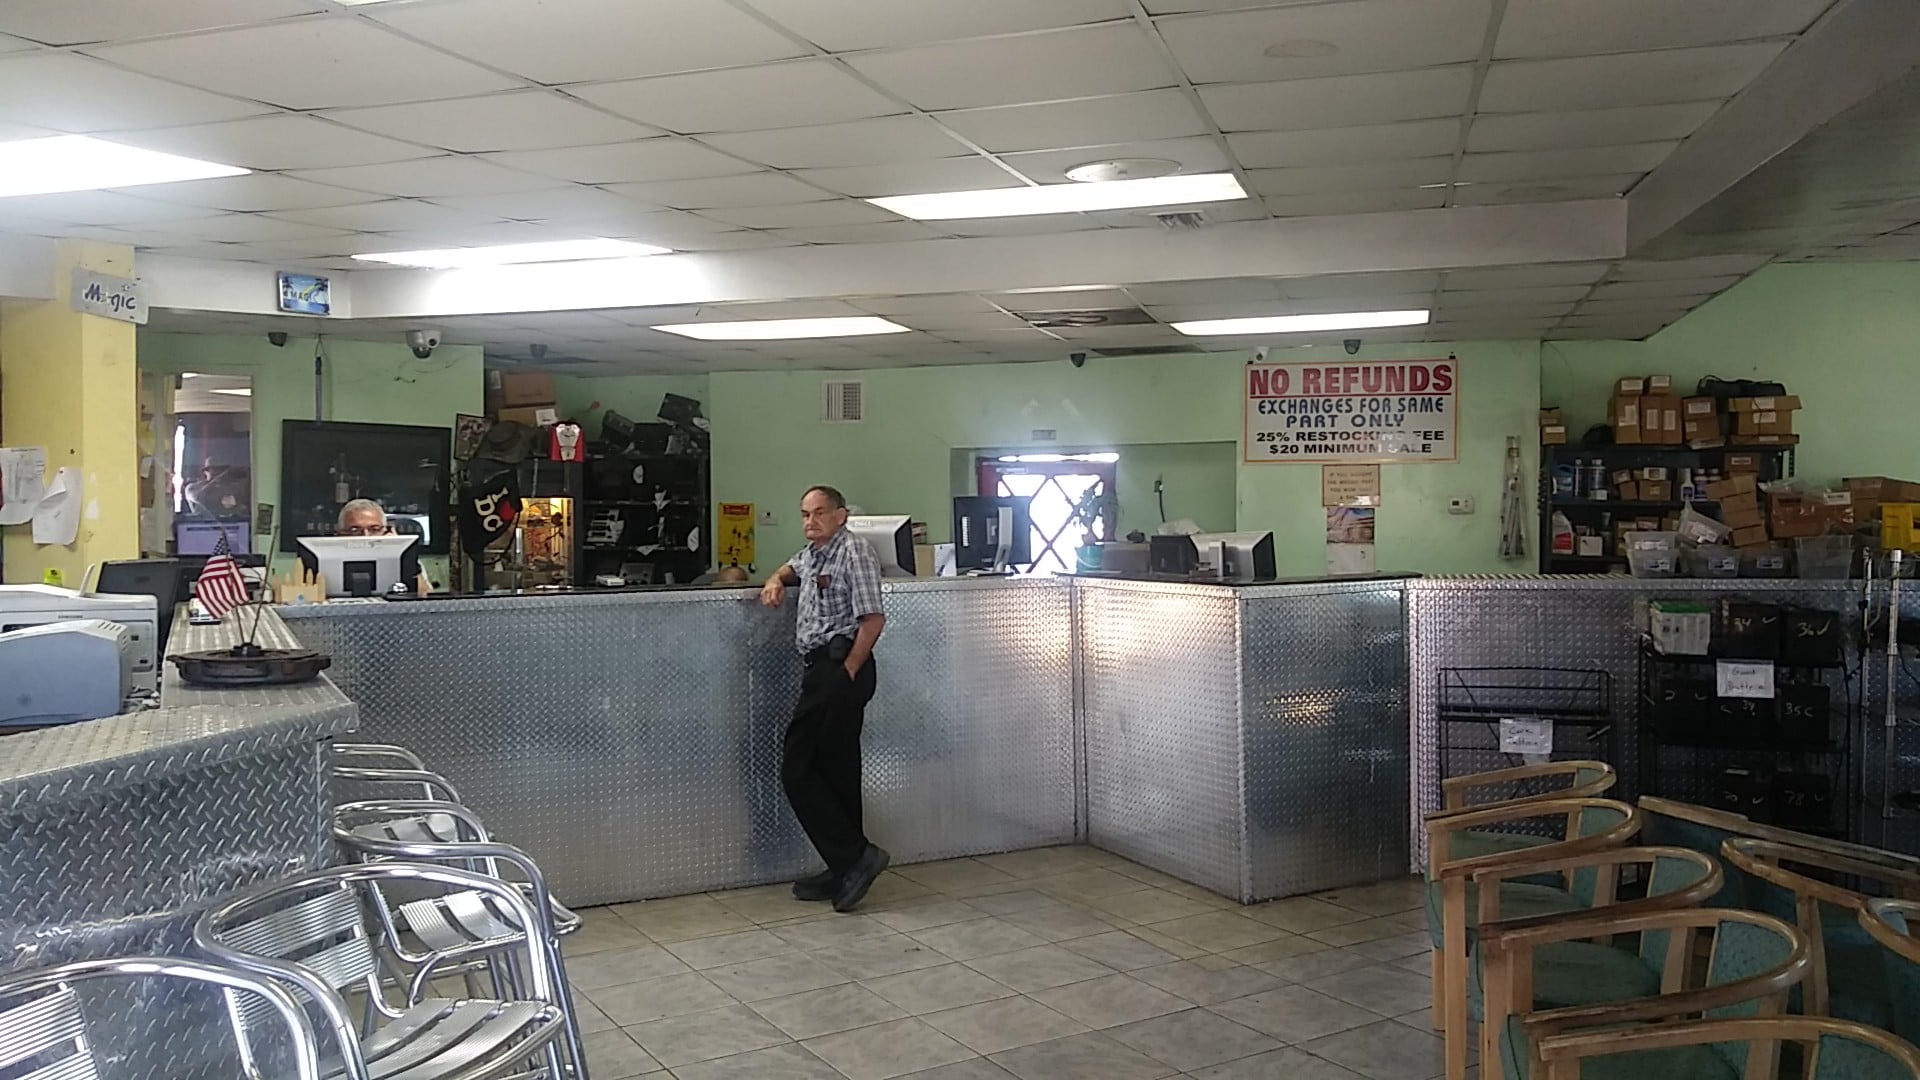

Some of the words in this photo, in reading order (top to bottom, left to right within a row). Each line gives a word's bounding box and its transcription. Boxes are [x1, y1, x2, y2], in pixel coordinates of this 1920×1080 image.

[1249, 369, 1290, 396] NO
[1302, 364, 1453, 394] REFUNDS
[1258, 397, 1353, 415] EXCHANGES
[1359, 396, 1392, 413] FOR
[1397, 396, 1444, 413] SAME
[1286, 414, 1339, 429] PART
[1350, 413, 1405, 428] ONLY
[1256, 431, 1290, 442] 25%
[1269, 444, 1299, 455] $20
[1303, 443, 1382, 454] MINIMUM
